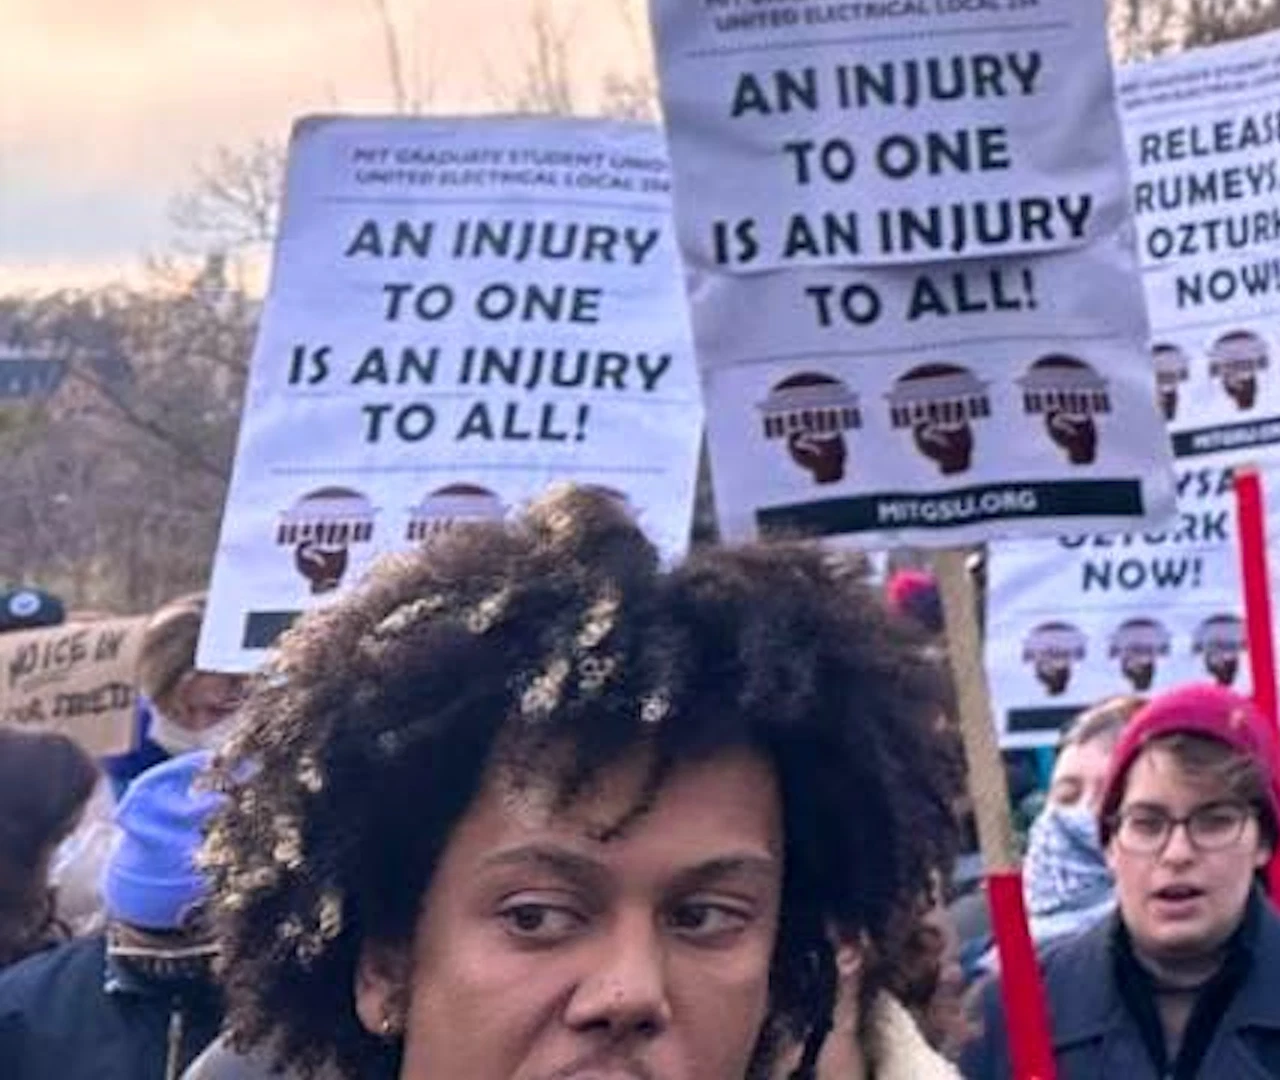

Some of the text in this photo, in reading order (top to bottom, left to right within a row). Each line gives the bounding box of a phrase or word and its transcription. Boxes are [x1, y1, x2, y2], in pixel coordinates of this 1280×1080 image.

[730, 51, 1042, 118] AN INJURY
[784, 129, 1011, 185] TO ONE
[345, 221, 659, 265] AN INJURY
[712, 195, 1093, 264] IS AN INJURY
[383, 284, 603, 323] TO ONE
[807, 268, 1037, 326] TO ALL!
[287, 346, 672, 391] IS AN INJURY
[360, 402, 591, 442] TO ALL!
[878, 491, 1037, 521] MITGSU.ORG
[1083, 558, 1203, 591] NOW!
